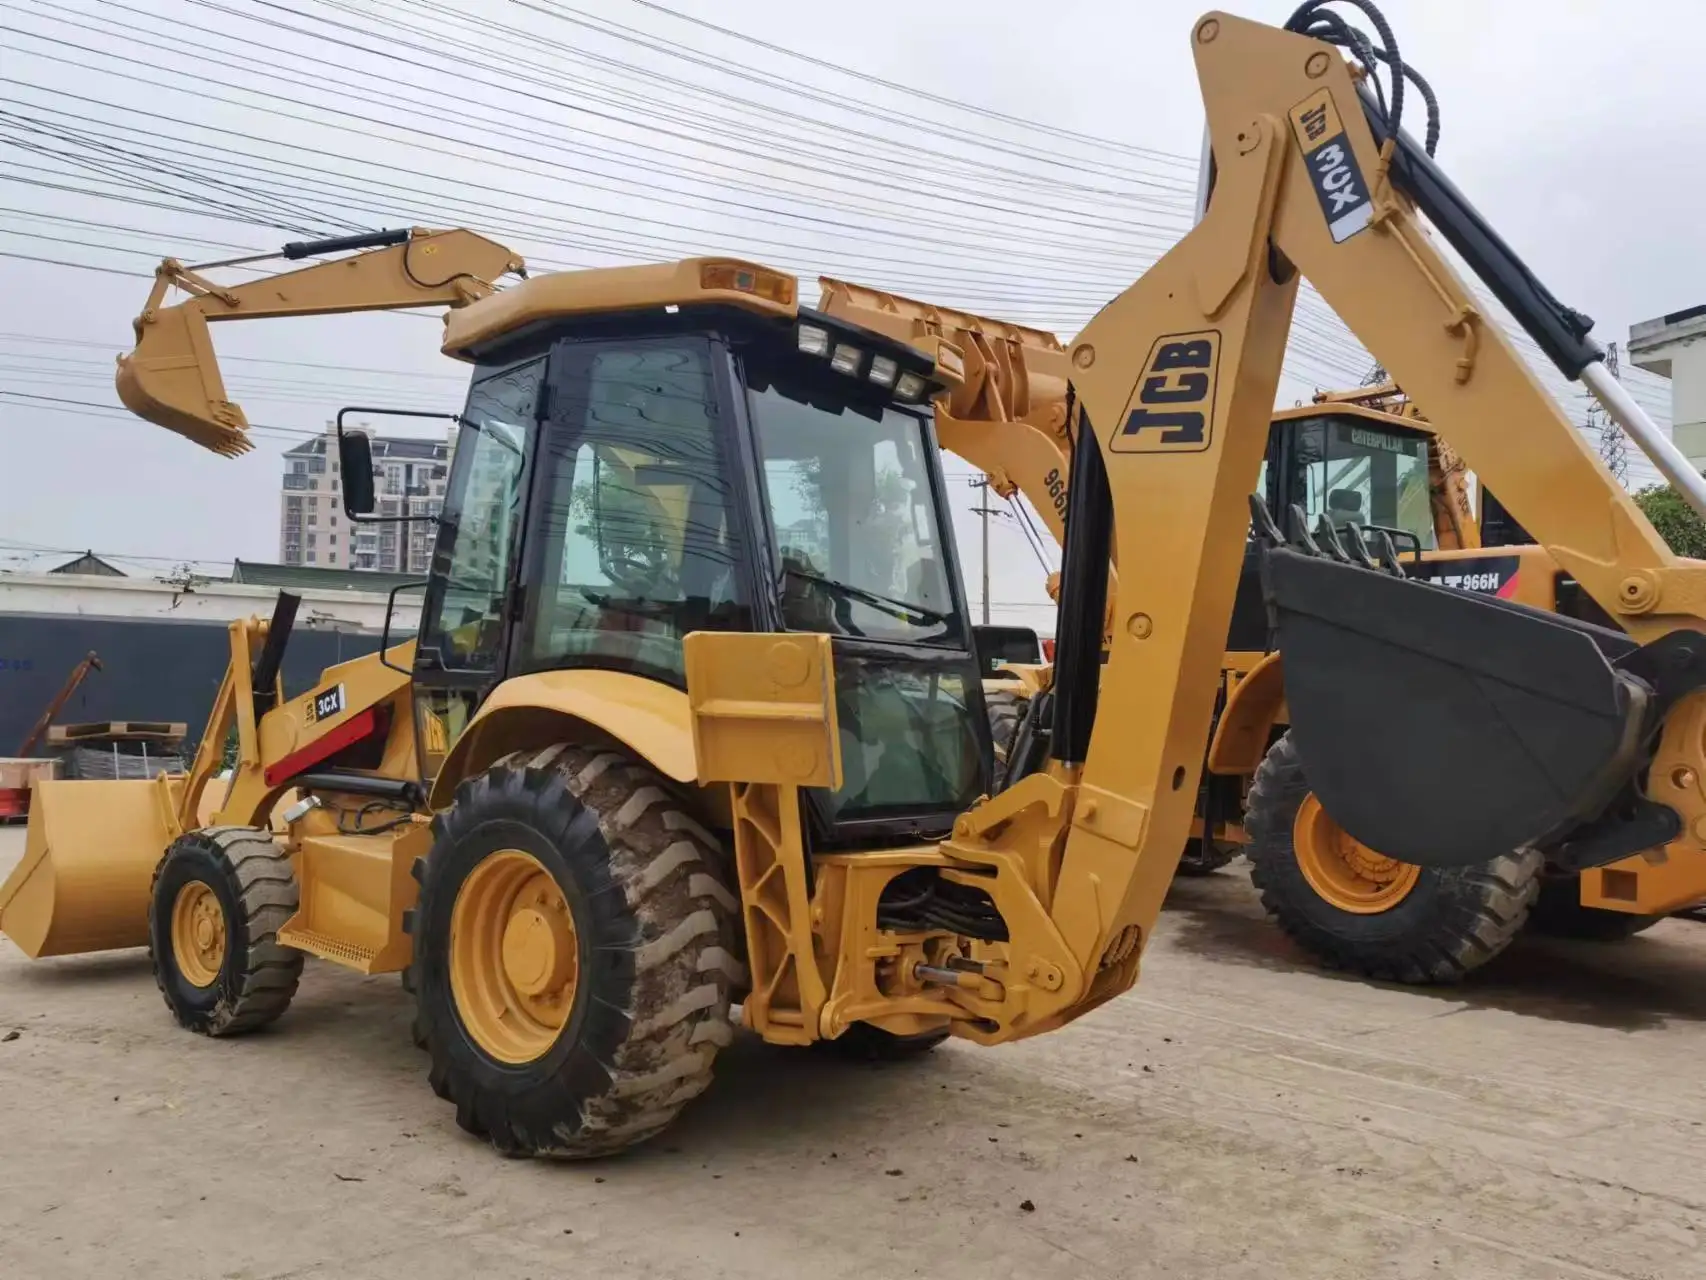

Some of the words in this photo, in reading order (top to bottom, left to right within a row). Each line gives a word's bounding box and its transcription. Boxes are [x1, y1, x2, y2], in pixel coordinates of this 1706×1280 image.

[1300, 103, 1326, 141] JCB
[1315, 143, 1360, 214] 3CX
[1122, 340, 1212, 443] JCB
[1351, 428, 1404, 452] CATERPILLAR
[1463, 573, 1499, 591] 966H
[318, 692, 338, 715] 3CX
